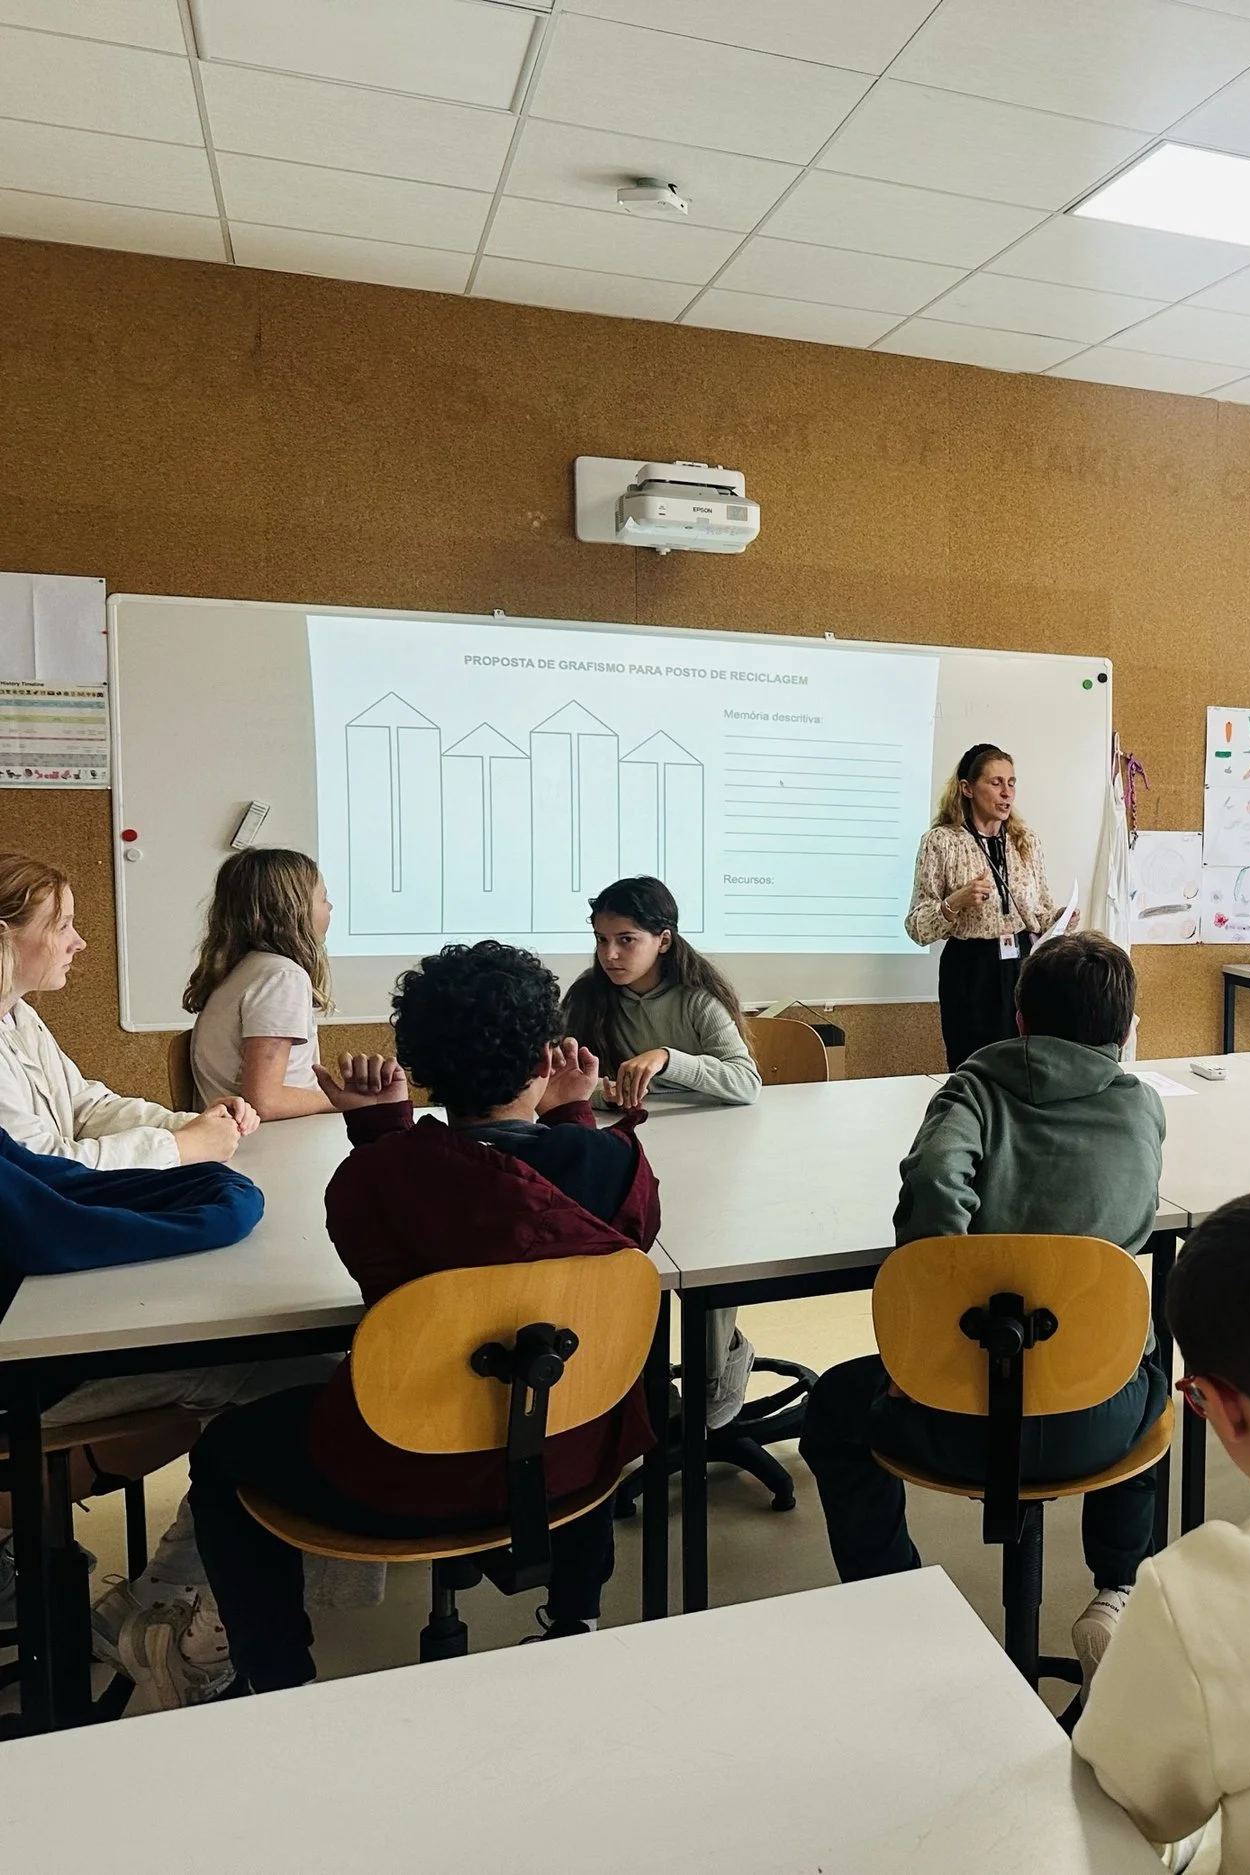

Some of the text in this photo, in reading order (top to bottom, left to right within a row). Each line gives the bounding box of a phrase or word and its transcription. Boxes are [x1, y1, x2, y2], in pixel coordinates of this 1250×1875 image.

[692, 506, 713, 514] EPSON
[464, 654, 809, 685] PROPOSTA DE GRAFISMO PARA POSTO DE RECICLAGEM
[723, 708, 824, 725] Memória descritiva:
[723, 874, 775, 886] Recursos:
